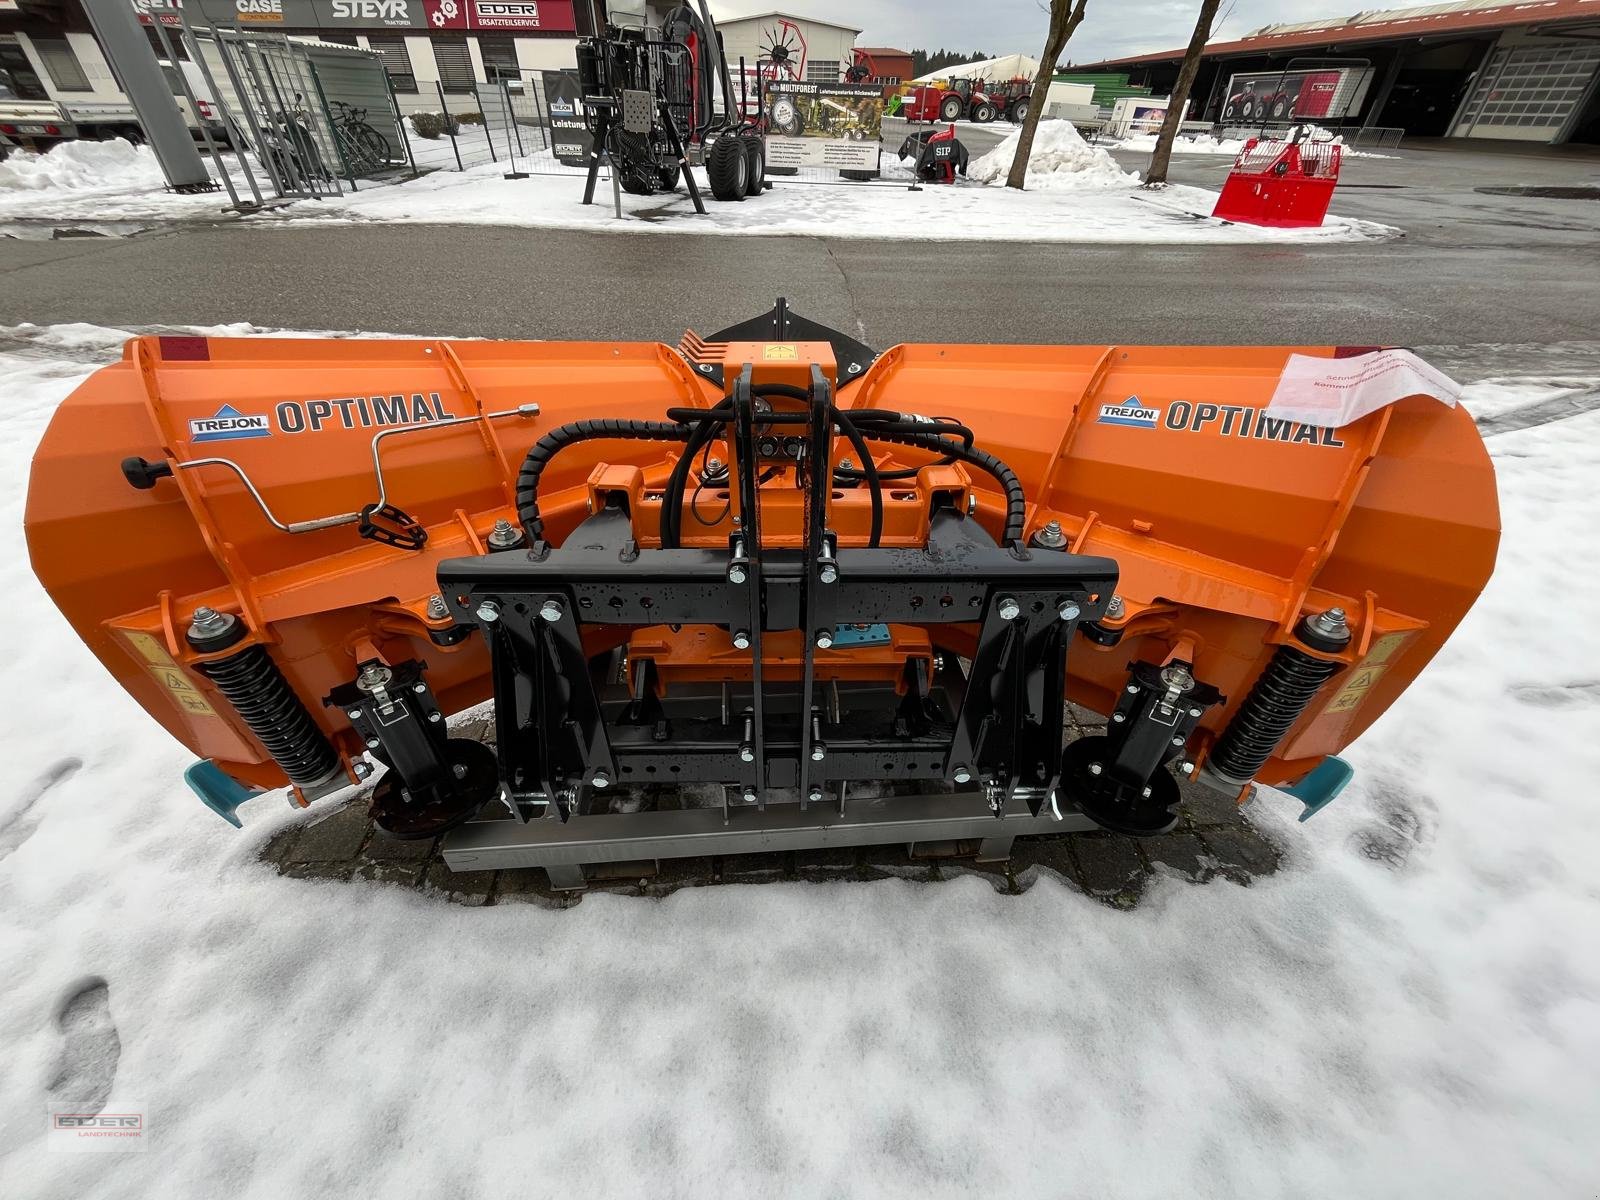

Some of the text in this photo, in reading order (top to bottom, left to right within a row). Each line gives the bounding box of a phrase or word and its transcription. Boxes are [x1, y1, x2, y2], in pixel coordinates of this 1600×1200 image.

[236, 0, 283, 13] CASE
[332, 0, 409, 18] STEYR
[478, 4, 535, 14] EDER
[478, 18, 541, 27] ERSATZTEILSERVICE
[780, 84, 818, 94] MULTIFOREST
[935, 146, 951, 156] SIP
[194, 393, 455, 433] TREJON OPTIMAL
[1103, 401, 1345, 448] TREJON OPTIMAL
